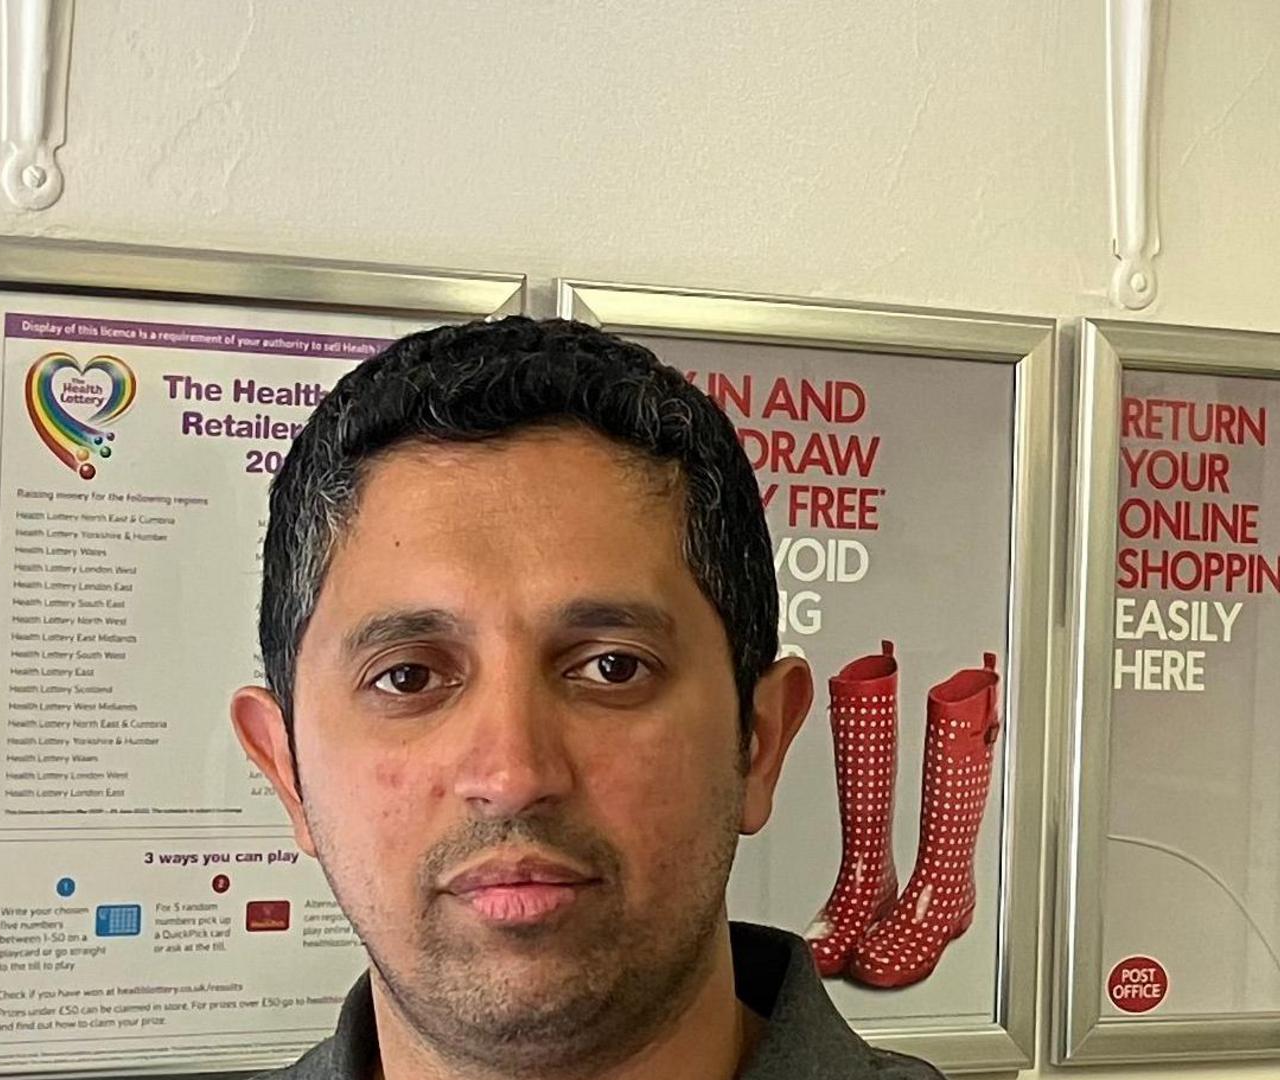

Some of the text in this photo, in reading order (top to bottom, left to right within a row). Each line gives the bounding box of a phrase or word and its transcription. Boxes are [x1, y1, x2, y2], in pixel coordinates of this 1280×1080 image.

[21, 320, 62, 335] Display
[64, 323, 78, 334] of
[78, 324, 99, 336] this
[138, 328, 148, 339] is
[149, 330, 157, 339] a
[158, 329, 222, 346] requirement
[224, 333, 236, 345] of
[237, 336, 261, 348] your
[262, 335, 309, 351] authority
[311, 338, 322, 350] to
[323, 339, 341, 351] sell
[63, 382, 103, 395] Health
[162, 375, 222, 401] The
[60, 392, 104, 407] Lottery
[762, 377, 866, 424] AND
[1122, 397, 1266, 446] RETURN
[738, 429, 880, 477] DRAW
[1121, 448, 1230, 493] YOUR
[17, 488, 209, 506] Raising money for the following regions
[1119, 498, 1259, 544] ONLINE
[773, 537, 869, 583] VOID
[1116, 598, 1243, 643] EASILY
[1114, 649, 1206, 691] HERE
[144, 850, 299, 866] 3 ways you can play
[0, 905, 89, 917] Write your chosen
[156, 901, 218, 912] For 5 random
[20, 920, 63, 929] numbers
[155, 915, 231, 927] numbers pick up
[162, 929, 209, 939] QuickPick
[210, 929, 231, 938] card
[166, 943, 181, 953] ask
[182, 943, 194, 953] at
[195, 942, 211, 952] the
[10, 961, 26, 971] the
[43, 961, 53, 970] to
[54, 960, 75, 972] play
[1121, 968, 1156, 983] POST
[38, 990, 56, 1000] you
[57, 987, 81, 998] have
[83, 988, 104, 997] won
[105, 986, 115, 996] at
[1112, 983, 1161, 999] OFFICE
